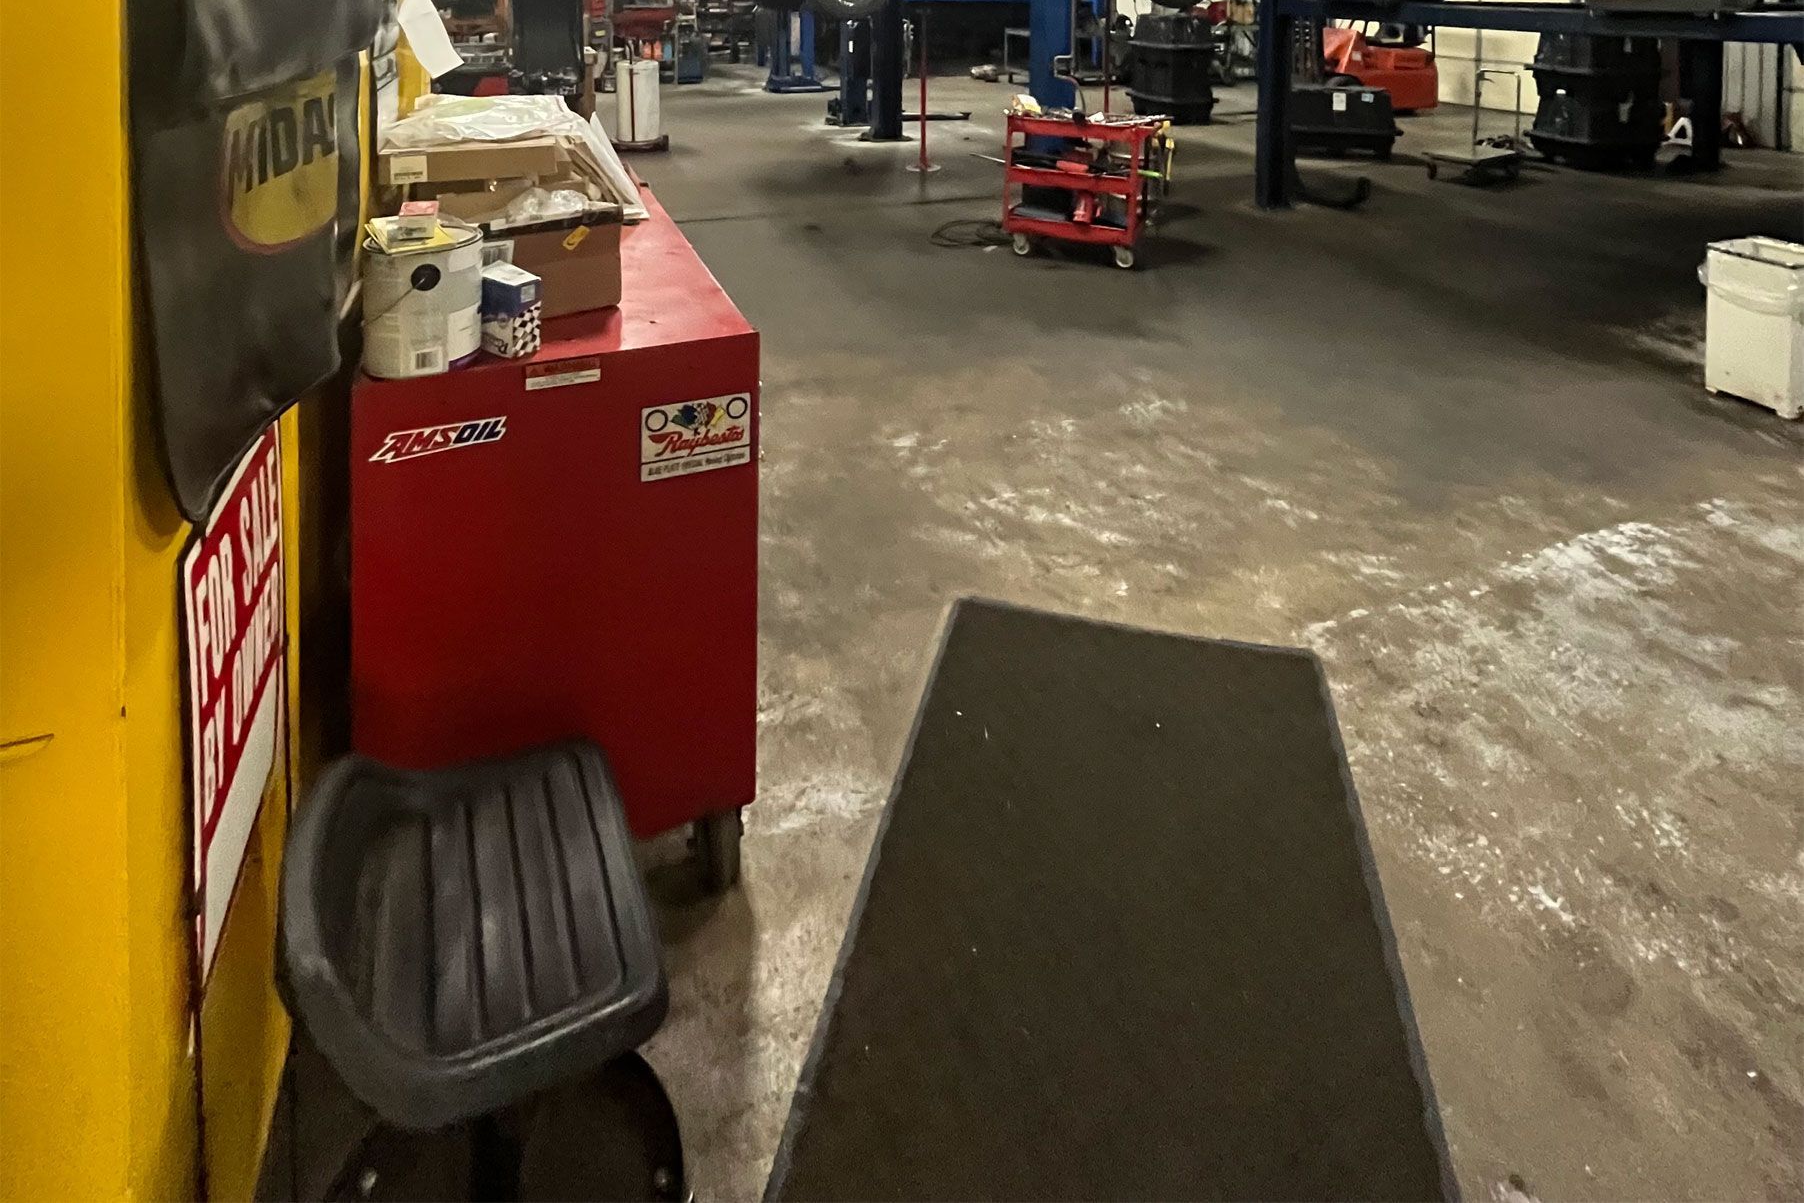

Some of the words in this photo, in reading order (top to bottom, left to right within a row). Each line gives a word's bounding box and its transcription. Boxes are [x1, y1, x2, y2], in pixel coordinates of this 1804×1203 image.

[229, 92, 336, 212] MIDA
[369, 417, 507, 462] AMSOIL
[648, 425, 745, 457] Raybestos
[196, 533, 237, 709] FOR
[239, 444, 278, 606] SALE
[203, 684, 226, 825] BY
[232, 560, 279, 746] OWNER
